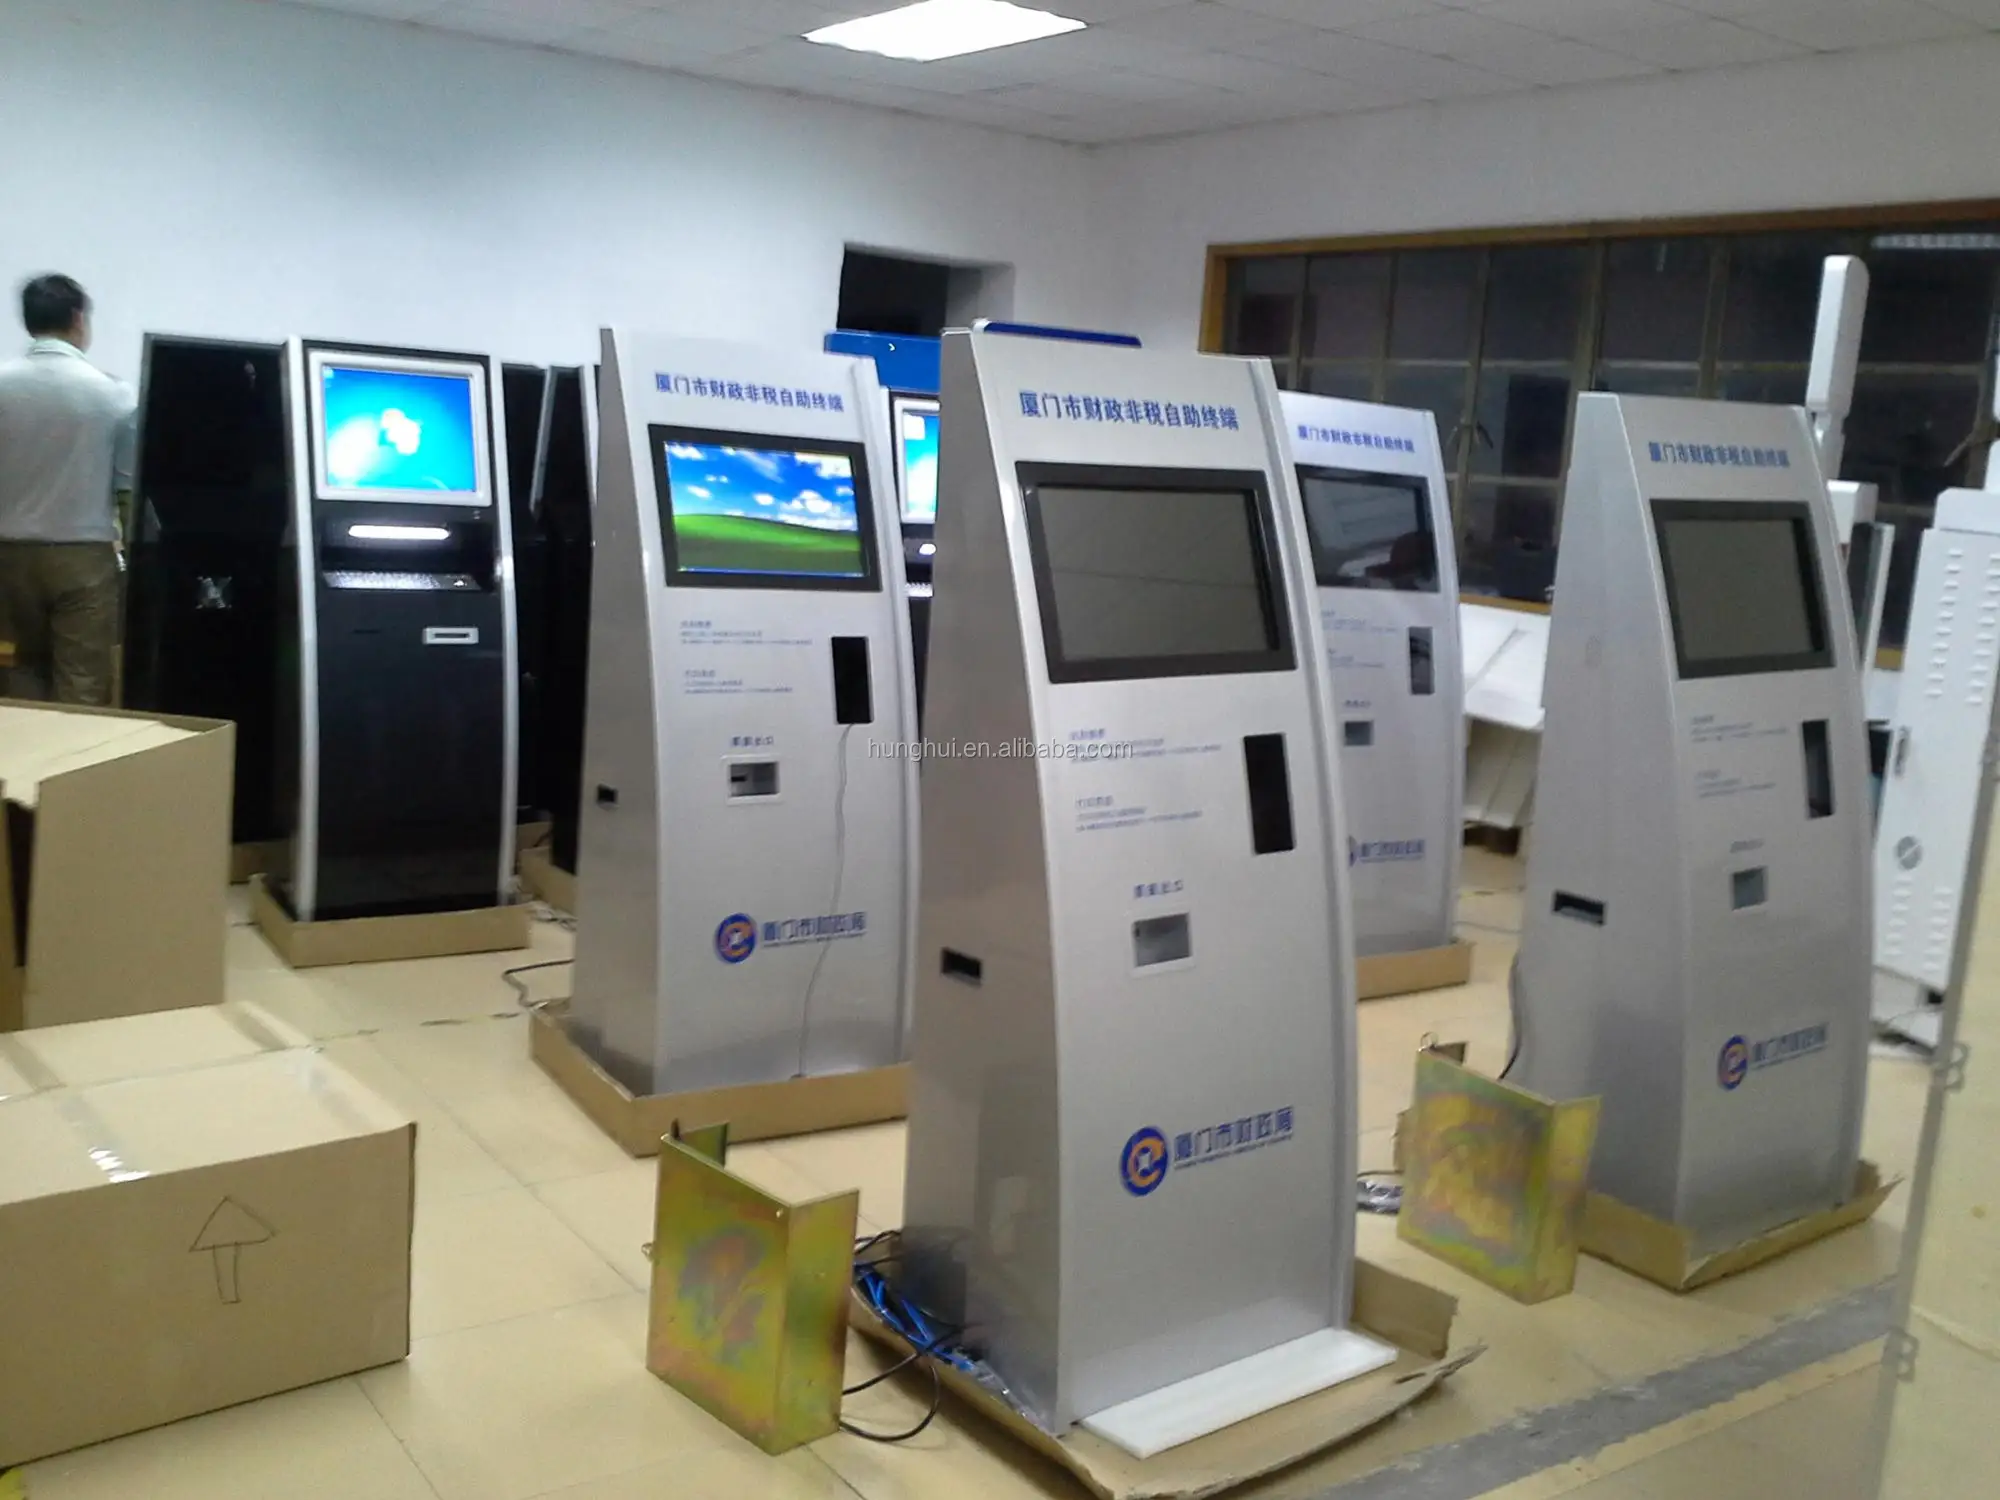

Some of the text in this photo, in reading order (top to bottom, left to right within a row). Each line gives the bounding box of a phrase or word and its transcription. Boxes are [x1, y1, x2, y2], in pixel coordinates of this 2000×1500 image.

[1019, 391, 1239, 431] 厦门市财政非税自助终端
